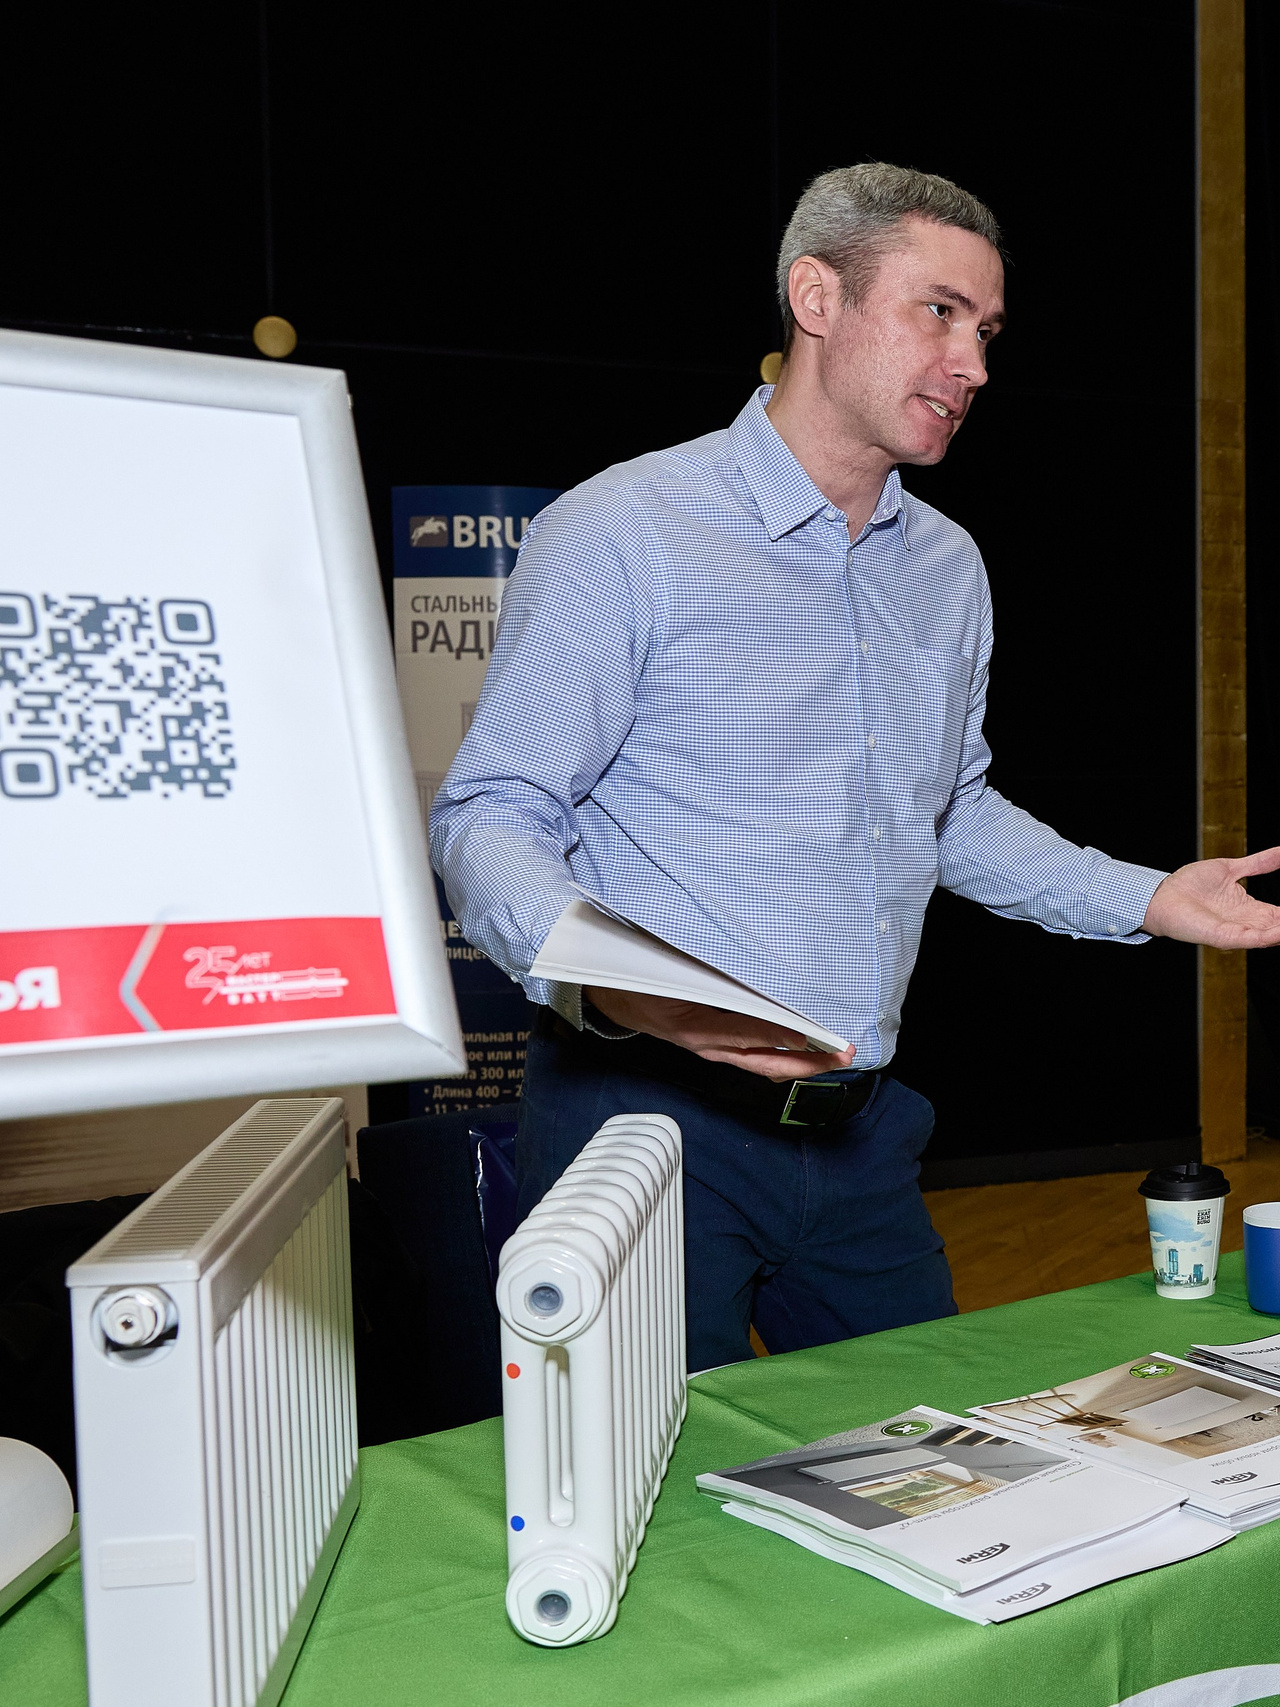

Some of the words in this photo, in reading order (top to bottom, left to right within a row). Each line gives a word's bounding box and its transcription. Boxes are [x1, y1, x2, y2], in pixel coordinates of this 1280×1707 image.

[480, 1066, 504, 1080] 300
[432, 1084, 473, 1100] Длина
[475, 1084, 500, 1099] 400
[1210, 1471, 1258, 1486] KERMI
[955, 1542, 1011, 1565] KERMI
[995, 1582, 1053, 1606] KERMI
